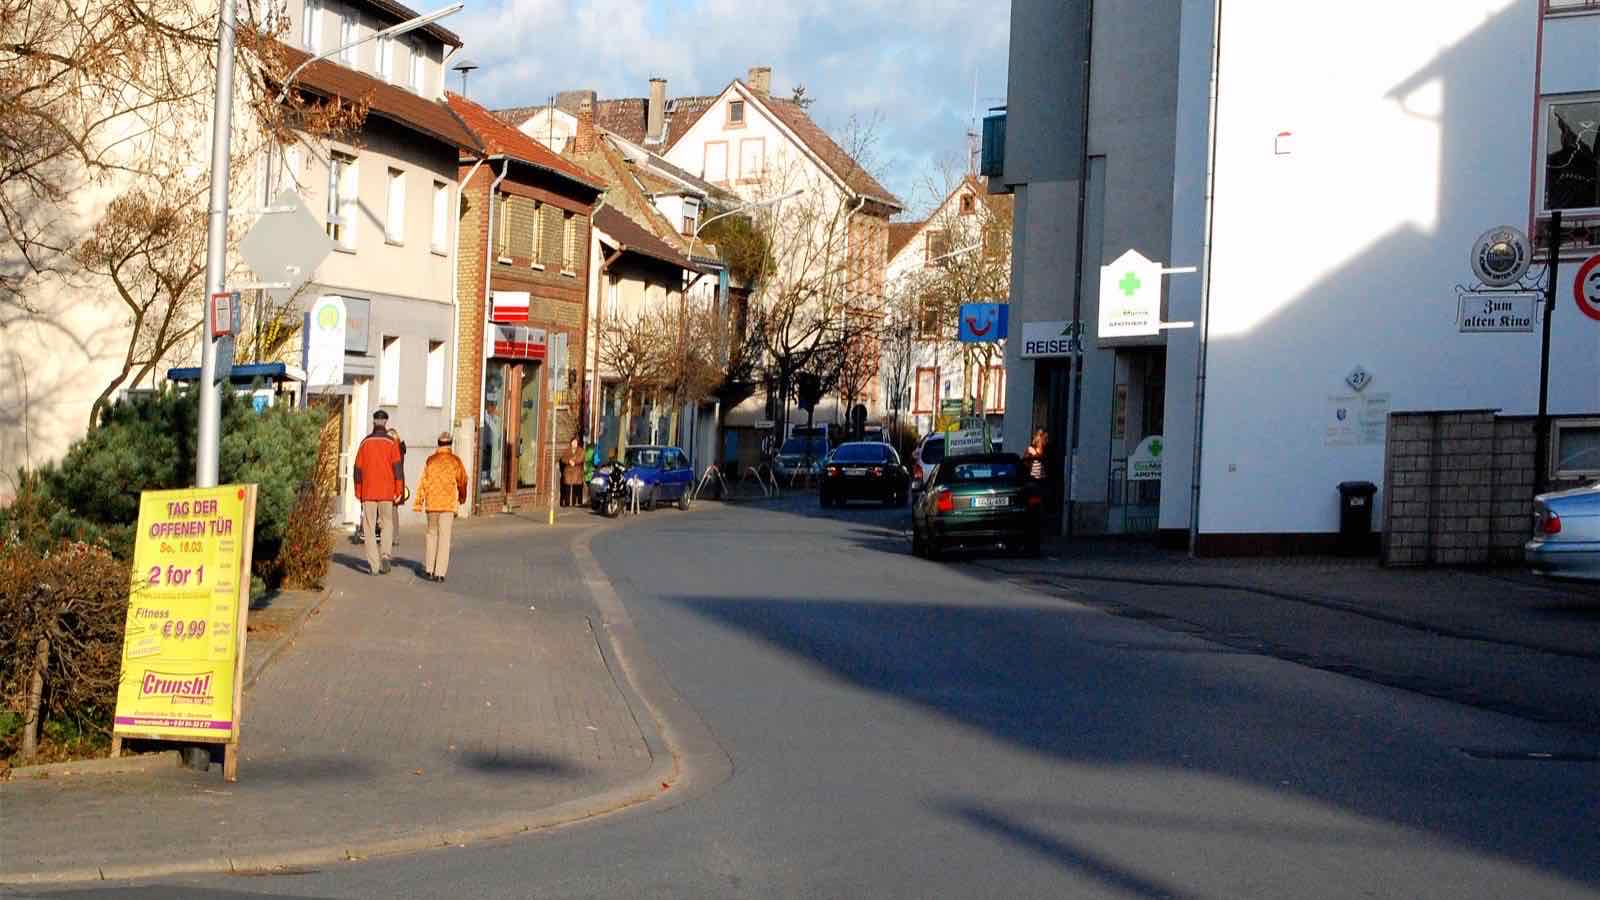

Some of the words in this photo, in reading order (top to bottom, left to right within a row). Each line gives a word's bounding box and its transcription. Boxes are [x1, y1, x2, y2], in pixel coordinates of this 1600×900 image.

[1483, 299, 1512, 314] Zum
[1464, 315, 1495, 327] alten
[1499, 315, 1530, 327] Kino
[1352, 372, 1366, 384] 27
[167, 501, 190, 516] TAG
[193, 500, 218, 514] DER
[150, 521, 206, 538] OFFENEN
[210, 516, 232, 537] TÜR
[149, 566, 161, 584] 2
[167, 564, 192, 585] for
[195, 565, 204, 584] 1
[135, 607, 170, 619] Fitness
[143, 674, 209, 695] Crunsh!
